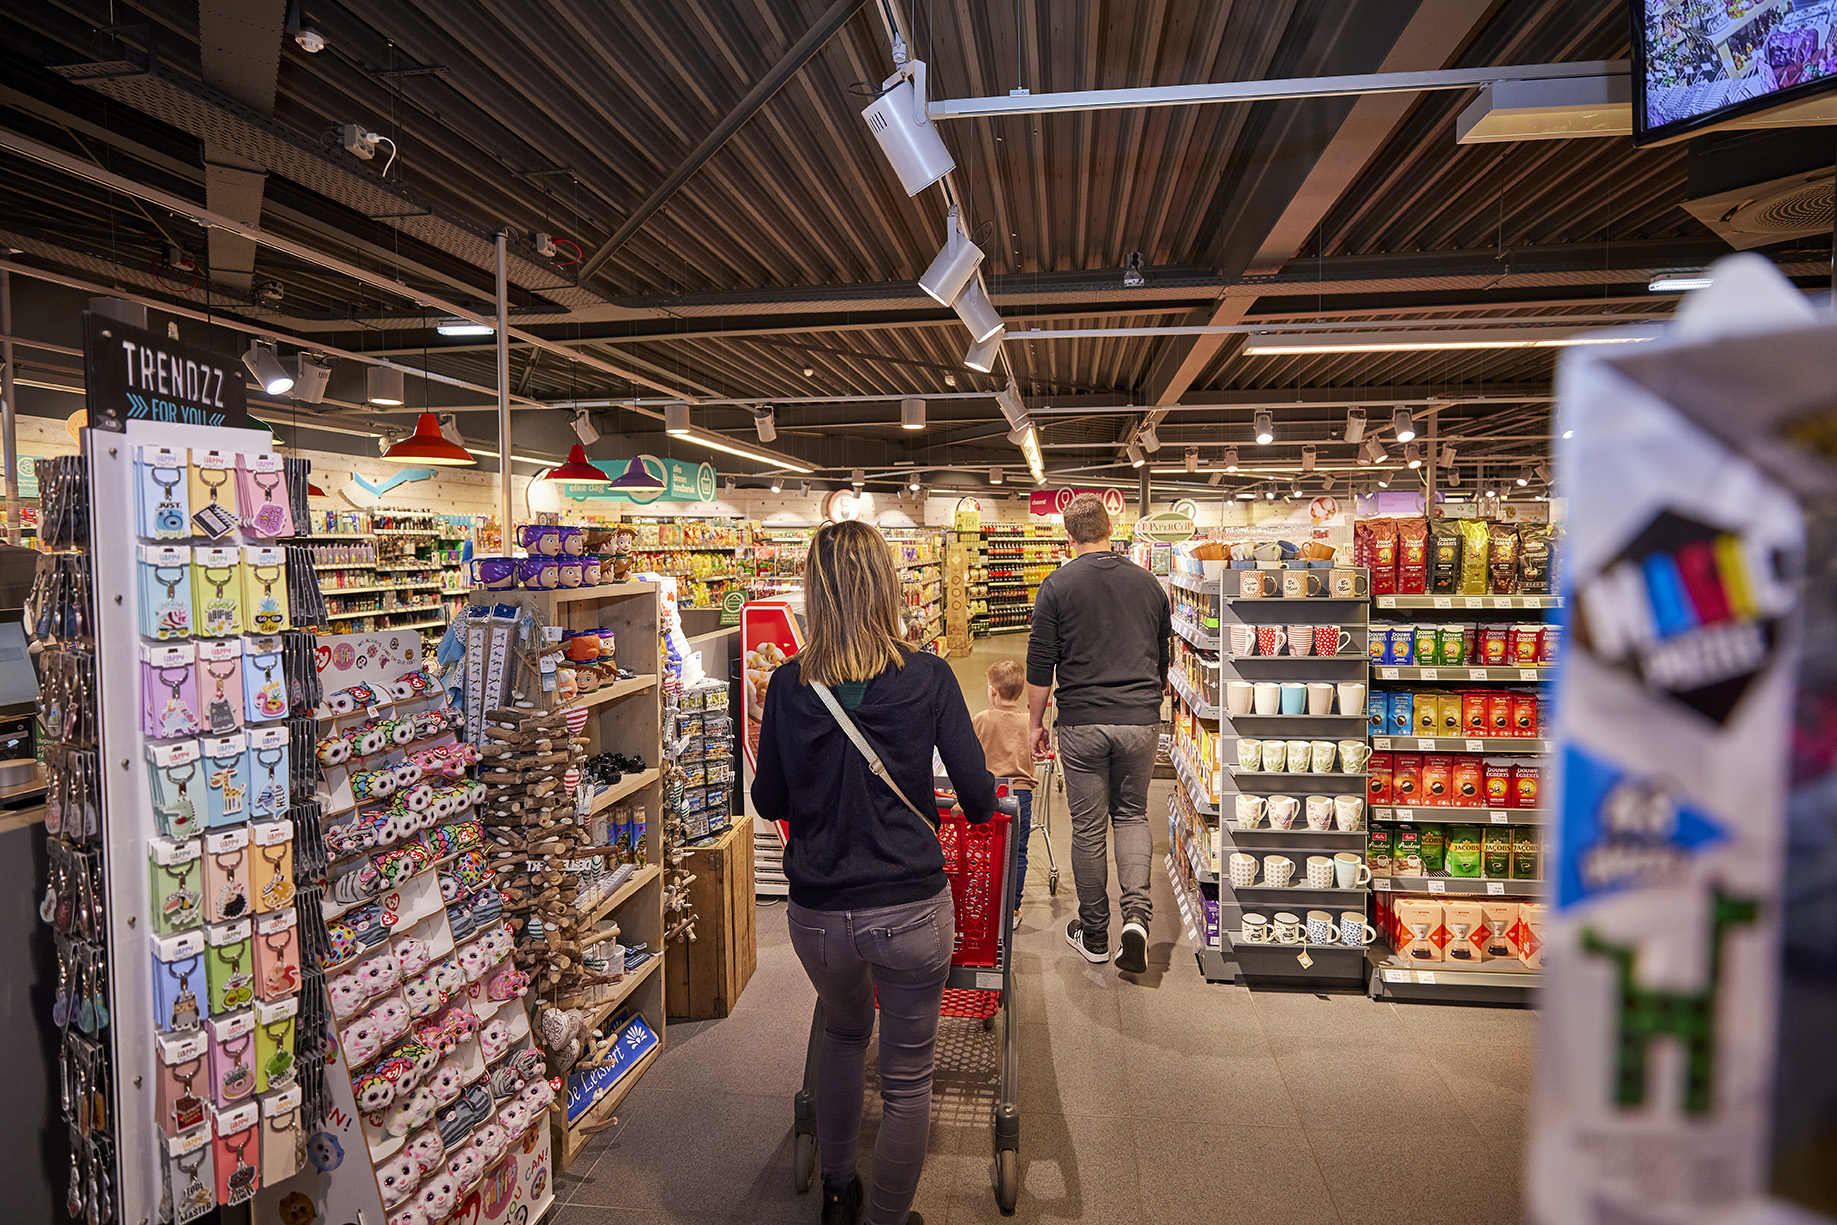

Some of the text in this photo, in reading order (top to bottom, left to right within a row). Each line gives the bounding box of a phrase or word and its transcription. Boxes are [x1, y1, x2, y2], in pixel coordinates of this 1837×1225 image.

[122, 340, 224, 408] TRENDZZ
[151, 398, 207, 426] FOR YOU
[569, 484, 605, 494] elke dag
[207, 600, 235, 610] GOOD
[208, 610, 233, 623] LIFE
[525, 1147, 548, 1181] CAN!
[484, 1164, 517, 1213] puffies
[180, 1203, 212, 1223] MASTER
[504, 1186, 523, 1225] YOU
